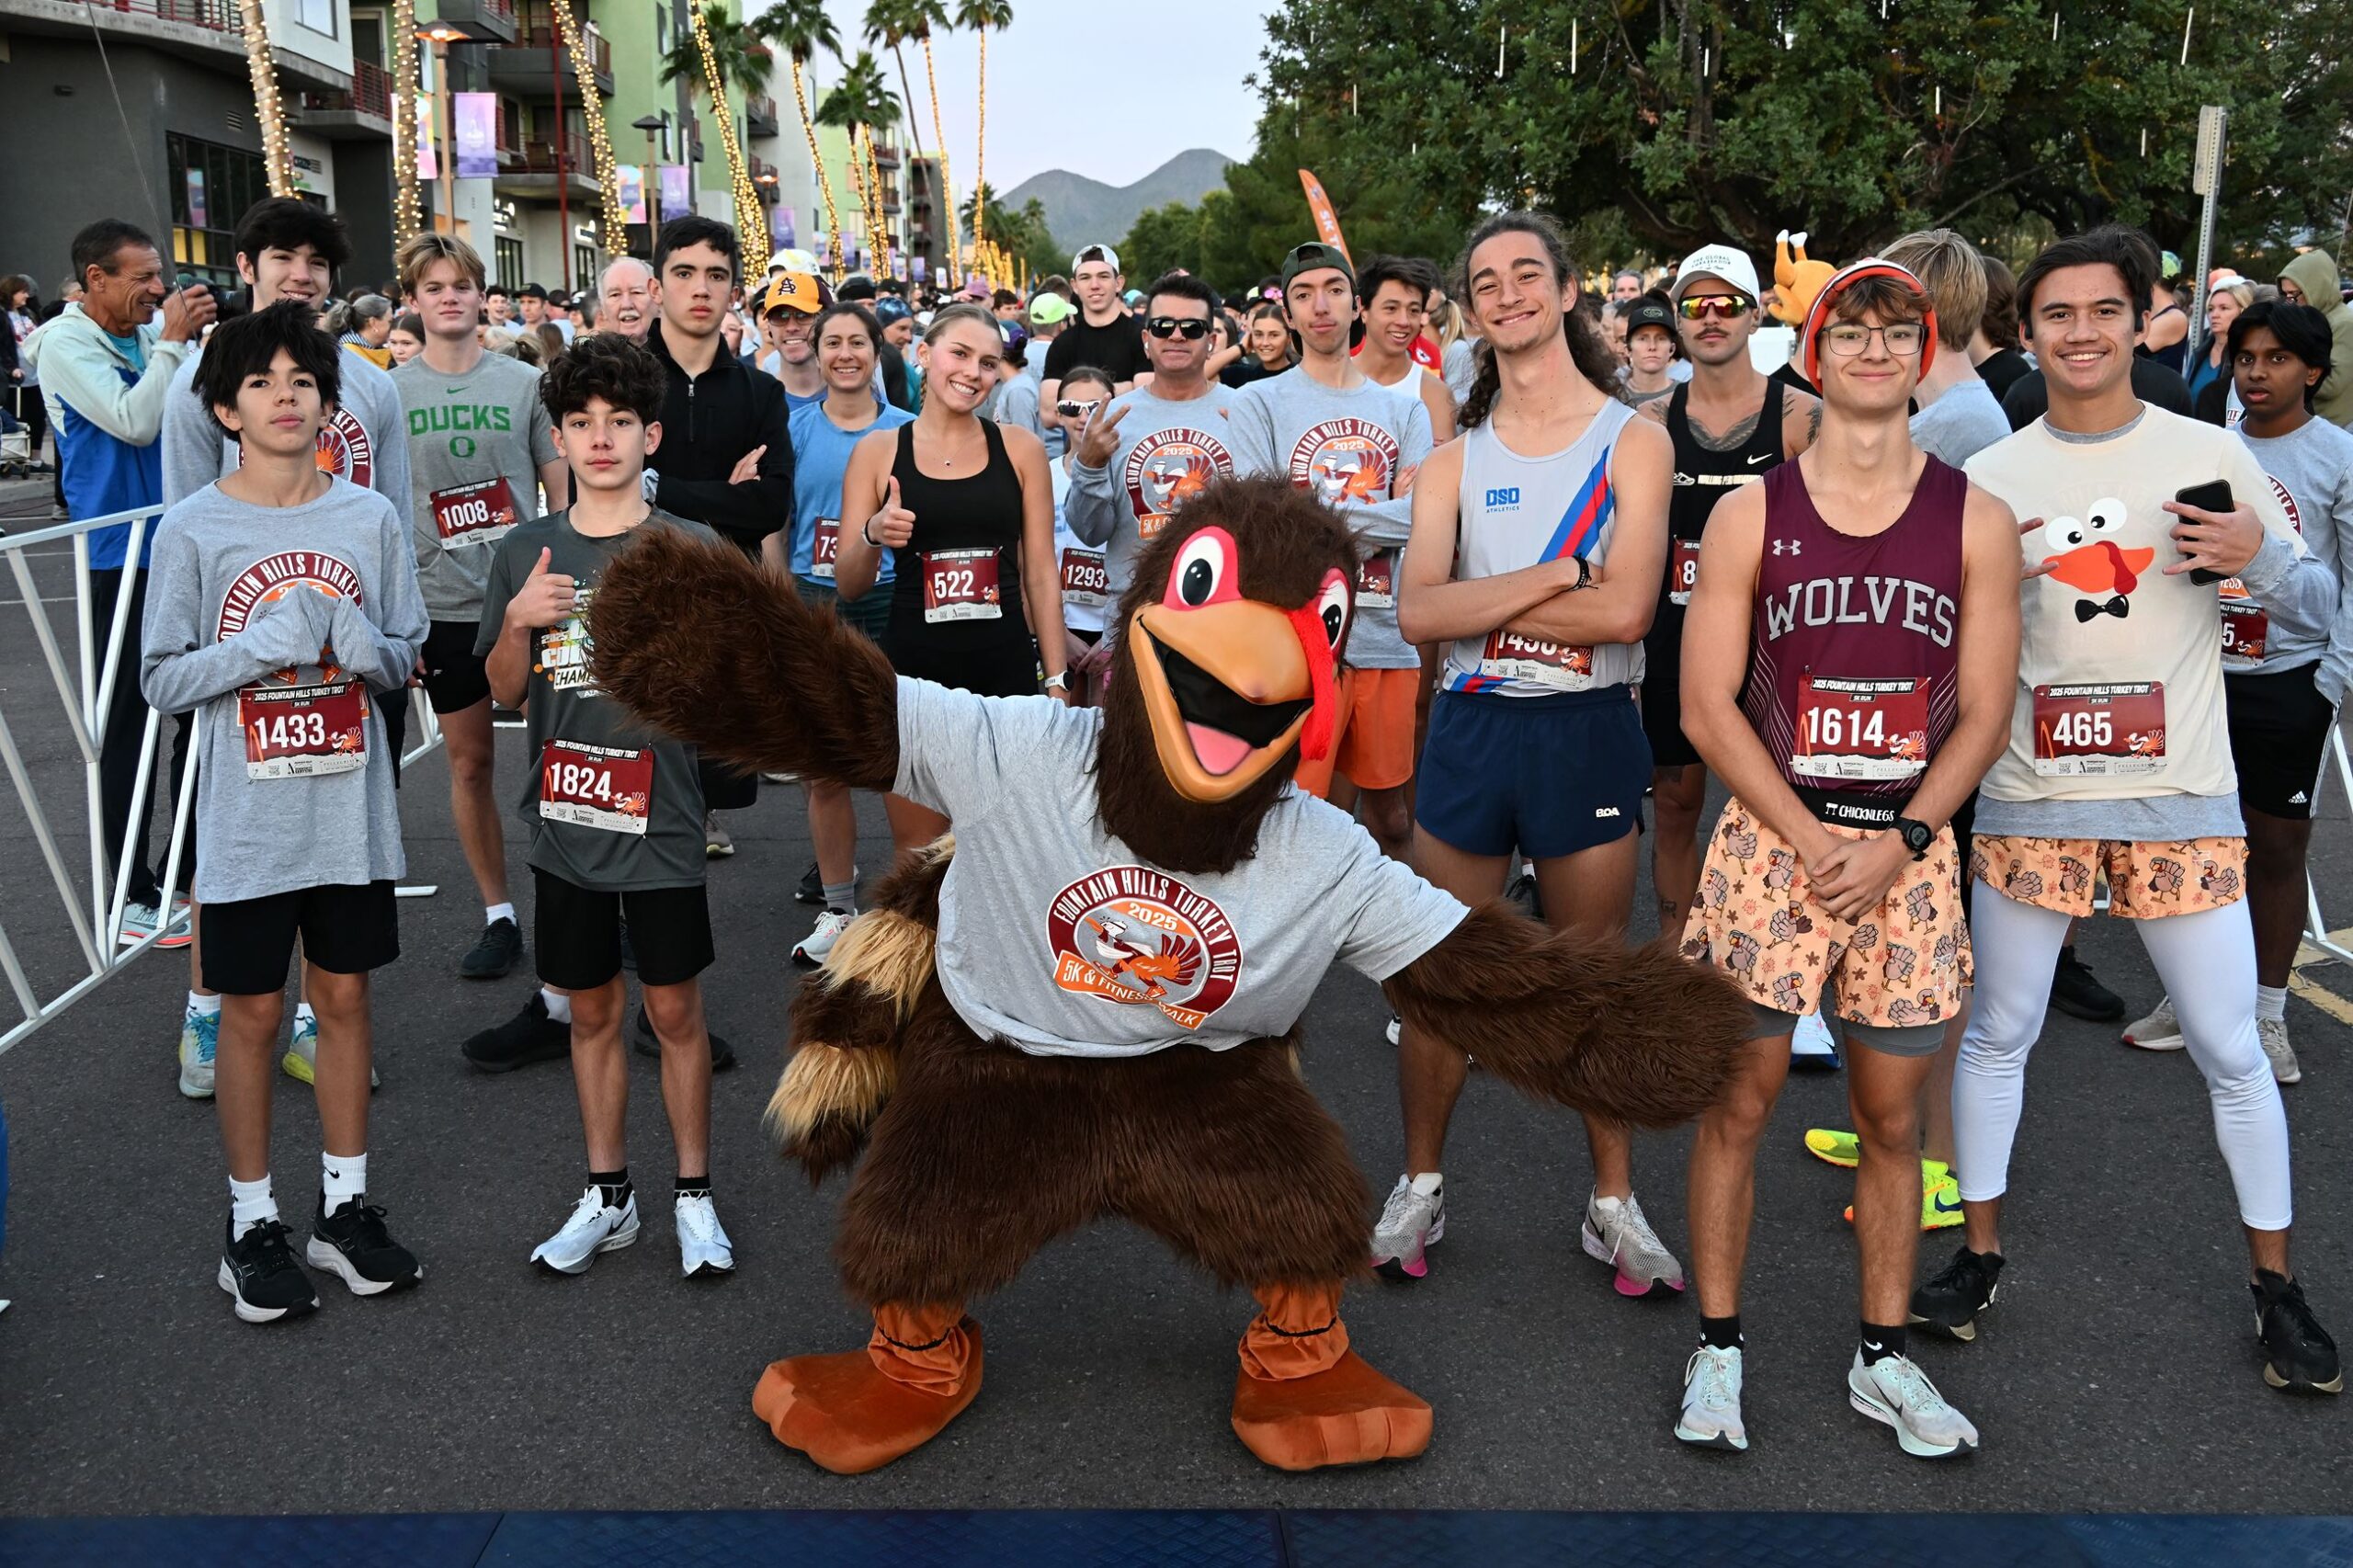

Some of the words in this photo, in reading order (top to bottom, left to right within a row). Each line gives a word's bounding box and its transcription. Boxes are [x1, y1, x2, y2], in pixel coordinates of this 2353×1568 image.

[408, 404, 511, 436] DUCKS
[332, 410, 358, 435] KEY
[349, 434, 369, 466] TROT
[1320, 419, 1352, 438] HILLS
[1358, 420, 1397, 453] TURKEY
[1332, 441, 1366, 450] 2025
[1127, 439, 1155, 490] FOUNTAIN
[1153, 429, 1184, 446] HILLS
[1188, 430, 1225, 460] TURKEY
[1163, 447, 1193, 456] 2025
[1486, 487, 1519, 506] DSD
[441, 500, 489, 529] 1008
[934, 570, 974, 599] 522
[1067, 564, 1105, 588] 1293
[221, 572, 265, 639] OUNTAIN
[259, 553, 306, 584] HILLS
[313, 555, 360, 597] TURKEY
[1766, 576, 1956, 648] WOLVES
[255, 692, 267, 701] 2025
[267, 690, 295, 700] FOUNTAIN
[295, 688, 311, 699] HILLS
[311, 687, 331, 697] TURKEY
[331, 685, 345, 694] TROT
[1813, 679, 1827, 689] 2025
[1826, 680, 1857, 690] FOUNTAIN
[1856, 682, 1874, 691] HILLS
[1874, 682, 1897, 691] TURKEY
[1897, 681, 1914, 691] TROT
[2050, 687, 2063, 697] 2025
[2063, 687, 2093, 696] FOUNTAIN
[2092, 686, 2110, 695] HILLS
[2109, 685, 2132, 695] TURKEY
[2132, 685, 2149, 694] TROT
[255, 712, 325, 750] 1433
[1807, 707, 1884, 747] 1614
[2052, 711, 2112, 746] 465
[554, 739, 567, 748] 2025
[566, 741, 591, 752] FOUNTAIN
[590, 744, 606, 754] HILLS
[605, 747, 625, 757] TURKEY
[624, 750, 639, 758] TROT
[551, 762, 611, 801] 1824
[1596, 807, 1620, 818] BOA
[1838, 805, 1894, 822] CHICKNLEGS
[1053, 870, 1120, 926] FOUNTAIN
[1120, 869, 1169, 900] HILLS
[1173, 886, 1232, 946] TURKEY
[1210, 949, 1238, 983] TROT
[1128, 902, 1177, 931] 2025
[1063, 960, 1081, 983] 5K
[1085, 970, 1097, 985] &
[1097, 975, 1155, 1001] FITNESS
[1158, 1001, 1199, 1025] WALK
